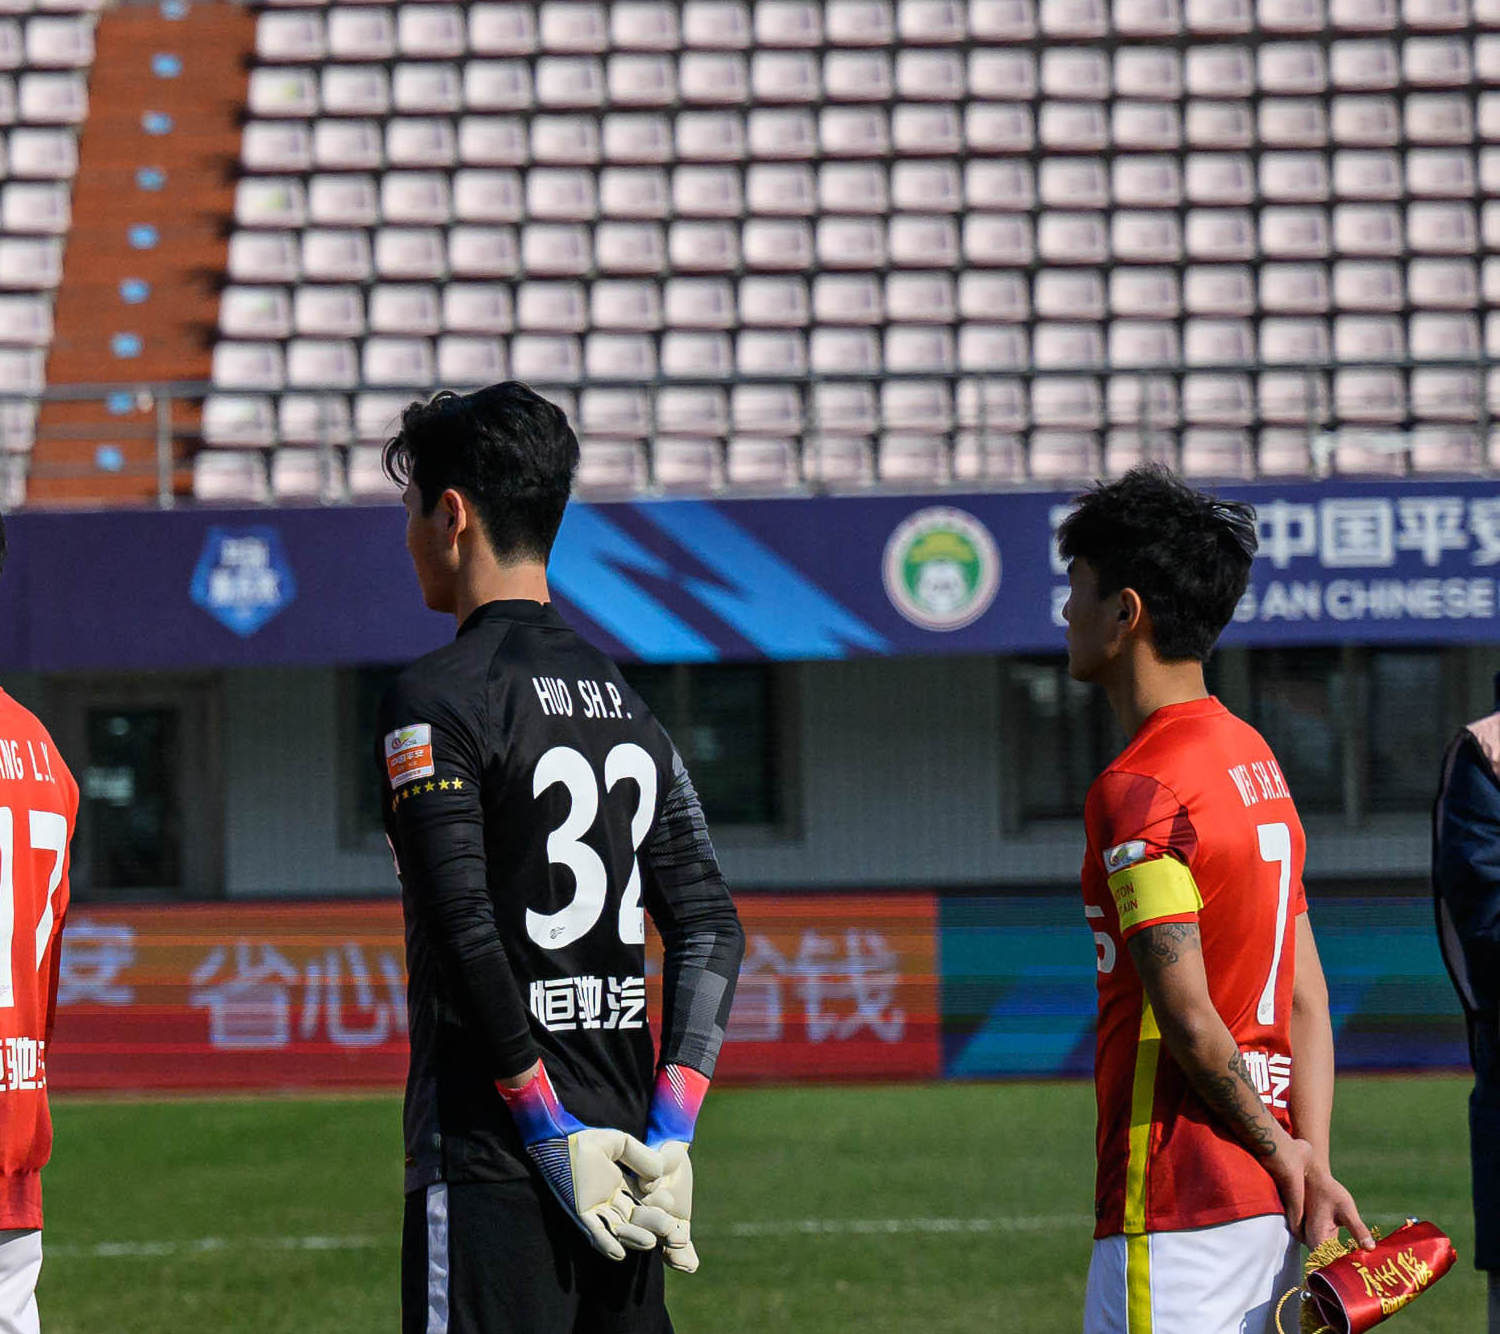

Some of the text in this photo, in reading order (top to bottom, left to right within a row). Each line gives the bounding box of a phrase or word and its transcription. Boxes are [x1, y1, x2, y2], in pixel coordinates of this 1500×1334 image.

[1323, 576, 1493, 622] CHINESE
[532, 677, 632, 720] HUO SH.P.
[526, 743, 658, 951] 32
[1256, 822, 1292, 1026] 7
[529, 976, 647, 1032] 恒驰汽
